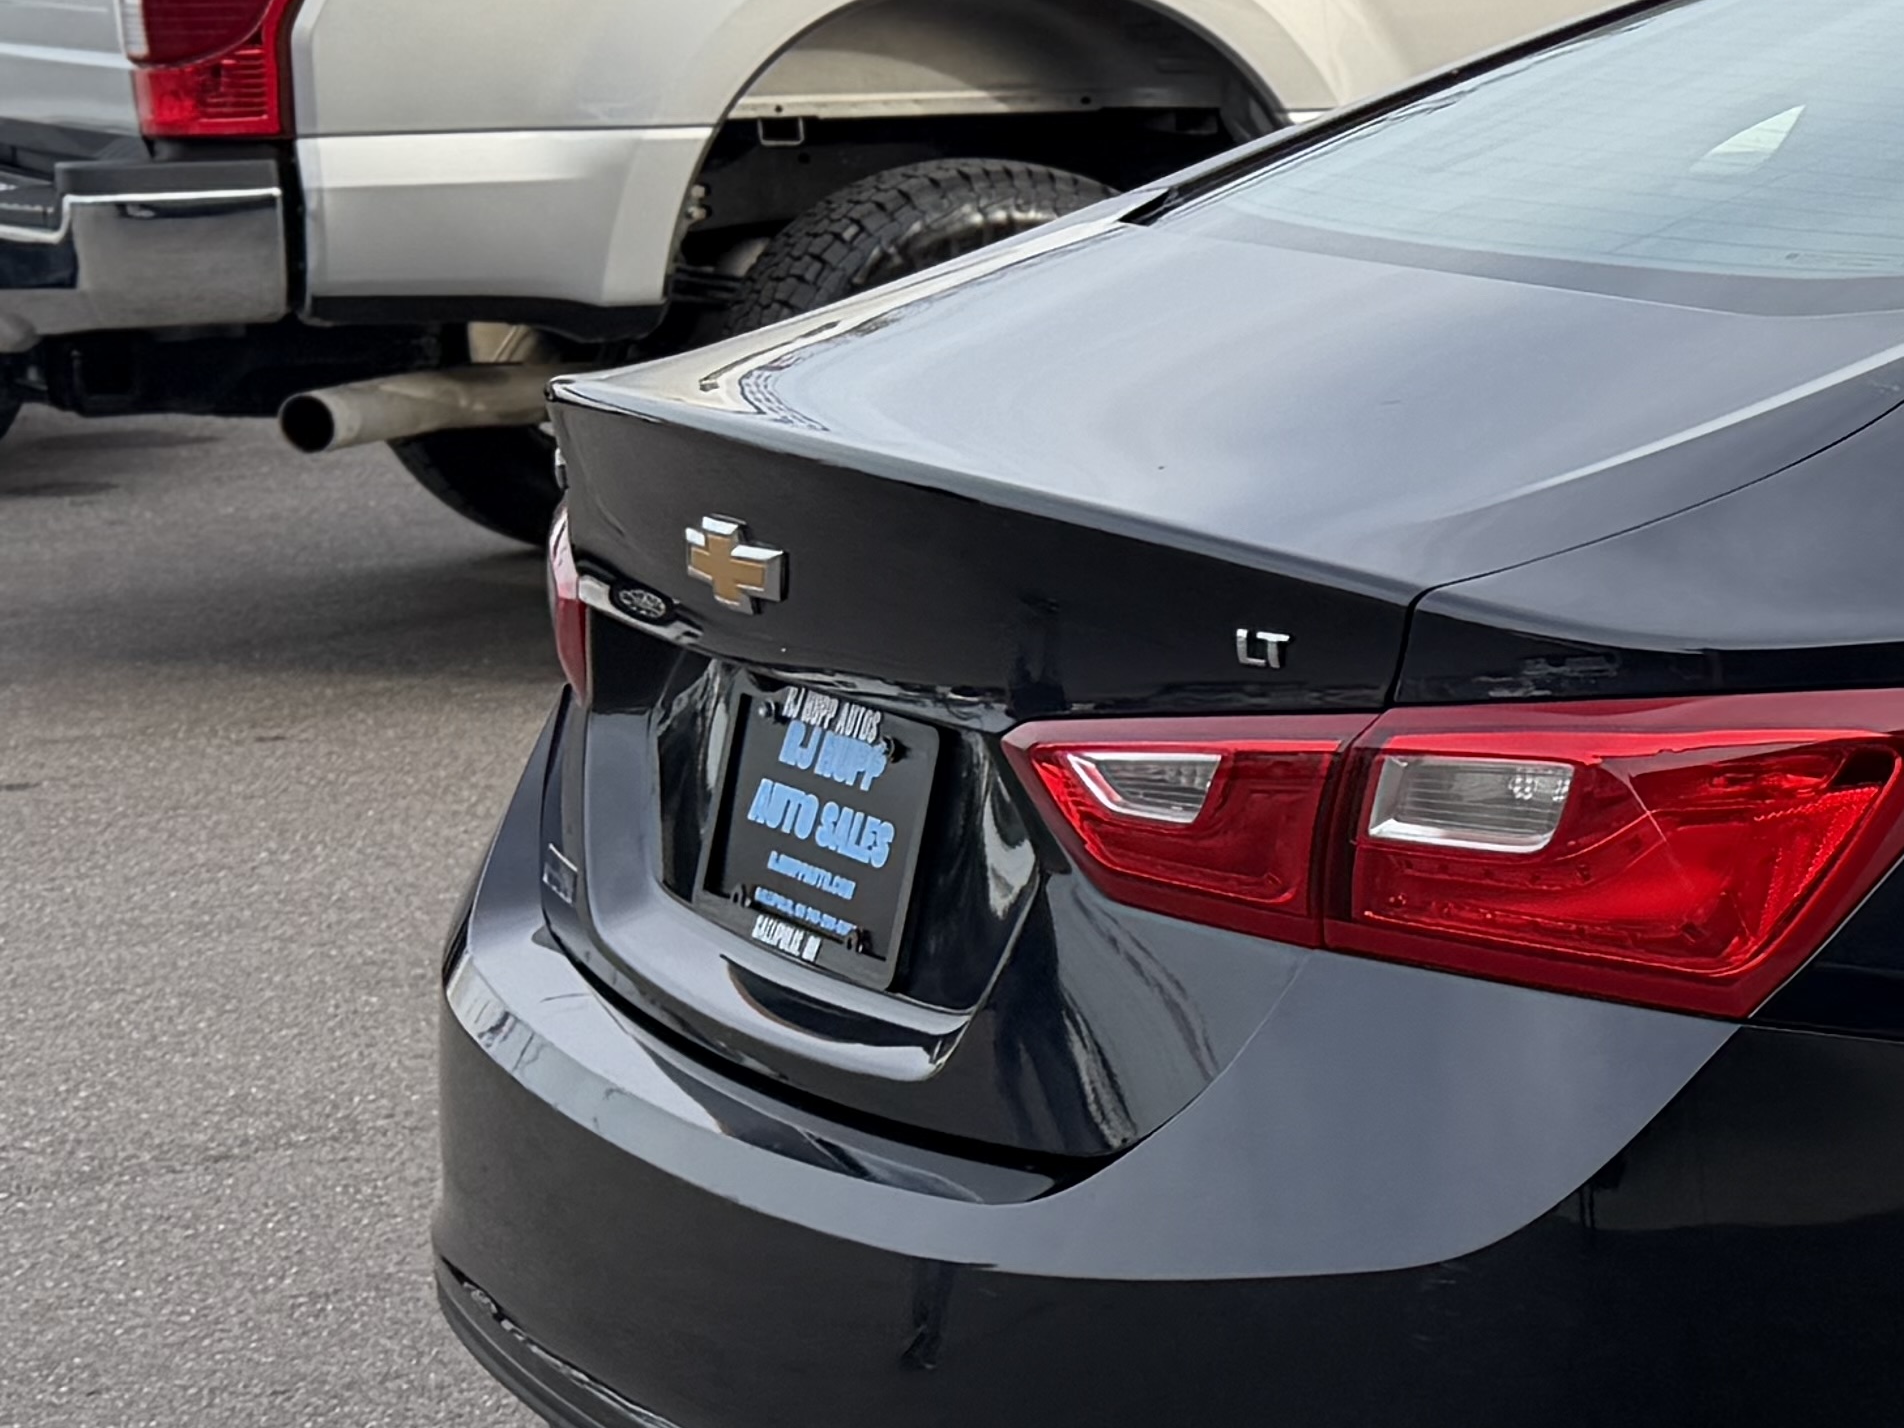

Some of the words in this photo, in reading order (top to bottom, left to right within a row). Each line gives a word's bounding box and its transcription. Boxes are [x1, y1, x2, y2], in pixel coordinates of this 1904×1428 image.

[1236, 628, 1290, 669] LT
[778, 720, 823, 770] RJ
[835, 702, 881, 744] AUTOS
[747, 778, 819, 840] AUTO
[815, 801, 895, 868] SALES
